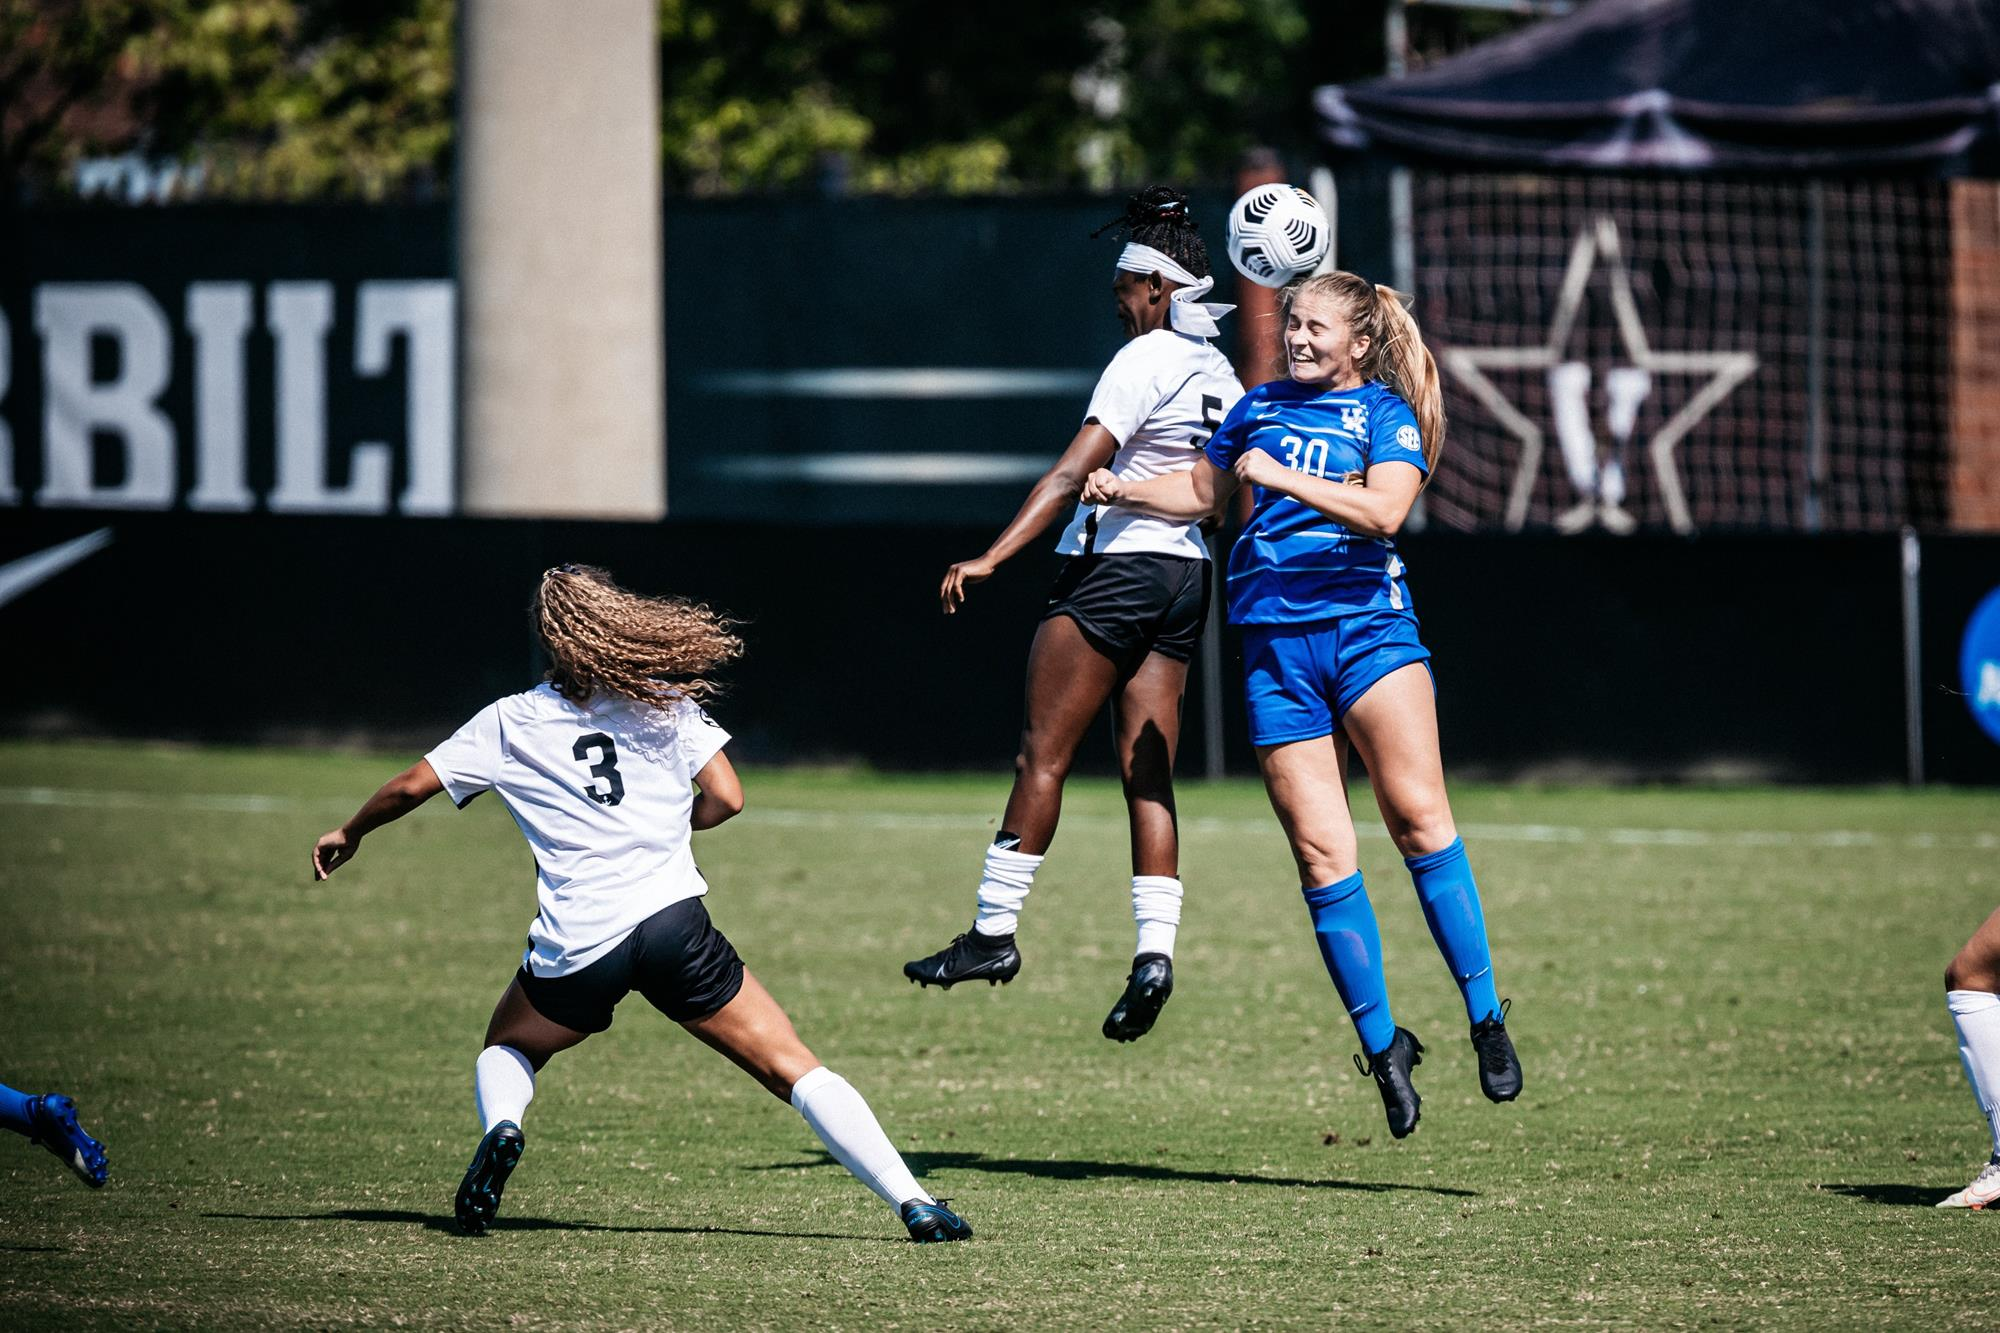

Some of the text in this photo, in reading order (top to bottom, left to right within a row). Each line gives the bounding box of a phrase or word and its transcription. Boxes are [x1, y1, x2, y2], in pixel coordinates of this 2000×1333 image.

[0, 279, 456, 517] BILT
[1190, 394, 1222, 450] 5
[1340, 406, 1368, 435] UK
[1280, 435, 1330, 478] 30
[1398, 426, 1420, 450] SEC
[572, 732, 625, 807] 3
